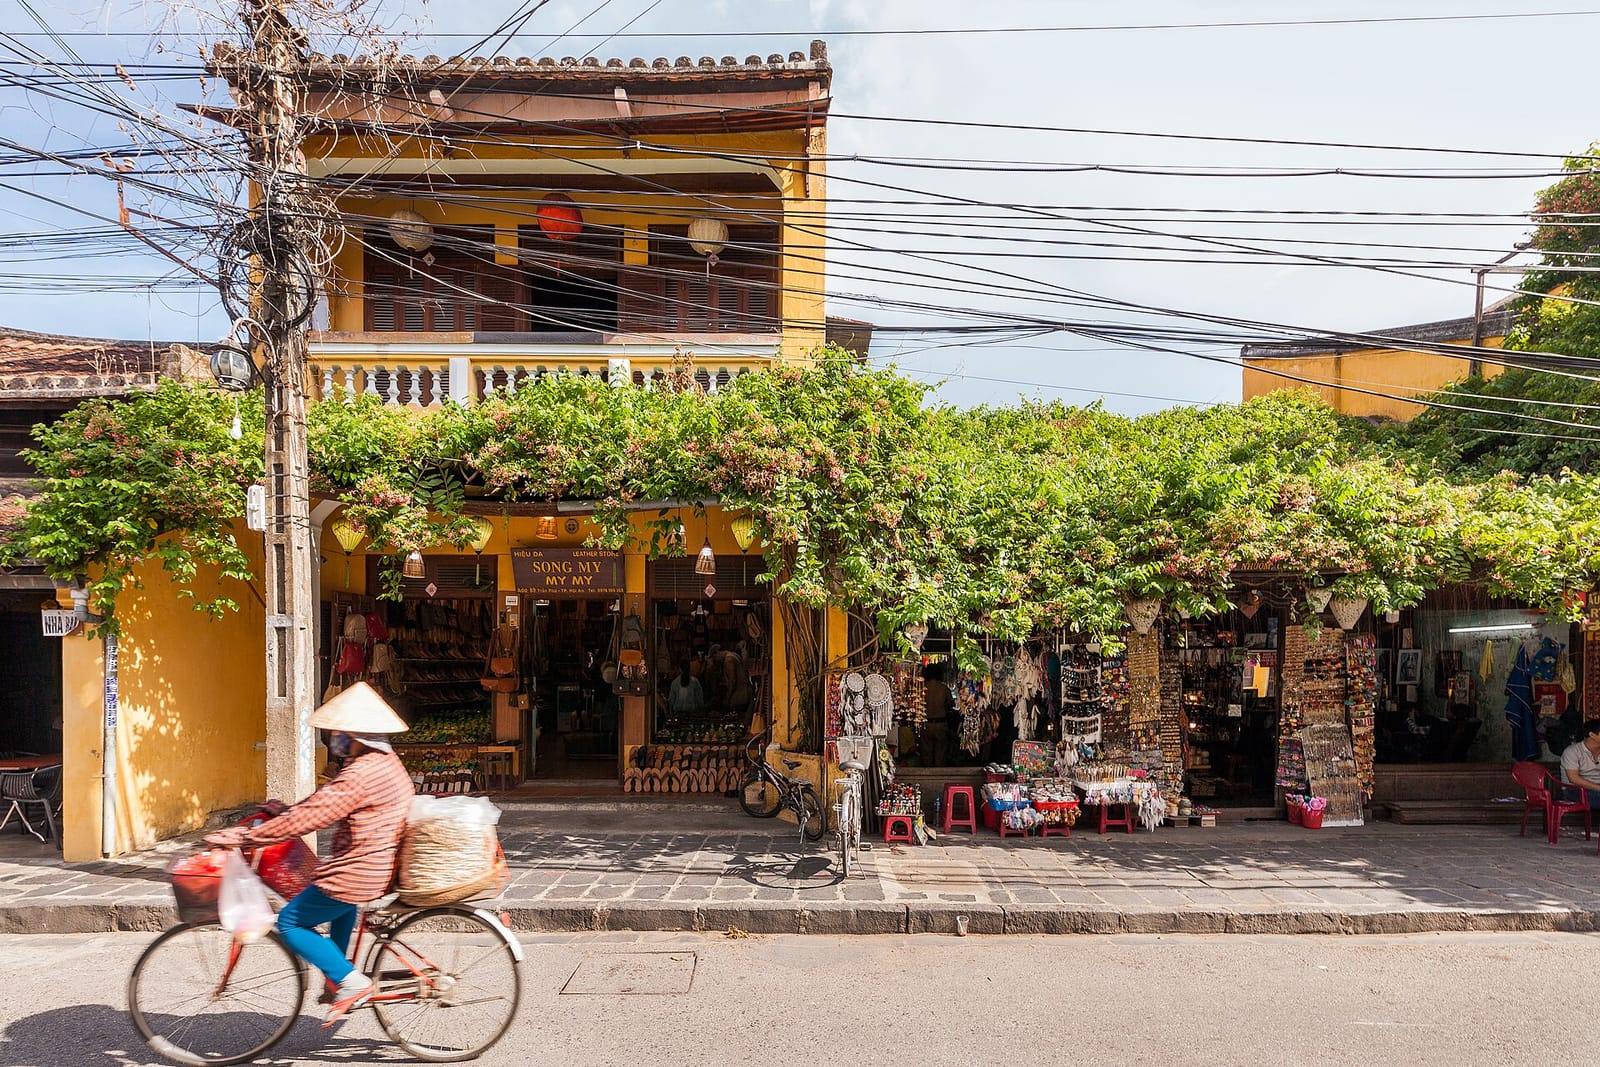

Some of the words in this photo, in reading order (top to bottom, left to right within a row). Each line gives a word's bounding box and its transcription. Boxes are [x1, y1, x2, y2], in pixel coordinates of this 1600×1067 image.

[532, 561, 573, 573] SONG
[578, 561, 602, 573] MY
[545, 575, 567, 586] MY
[572, 575, 593, 586] MY
[44, 611, 64, 634] NHÀ
